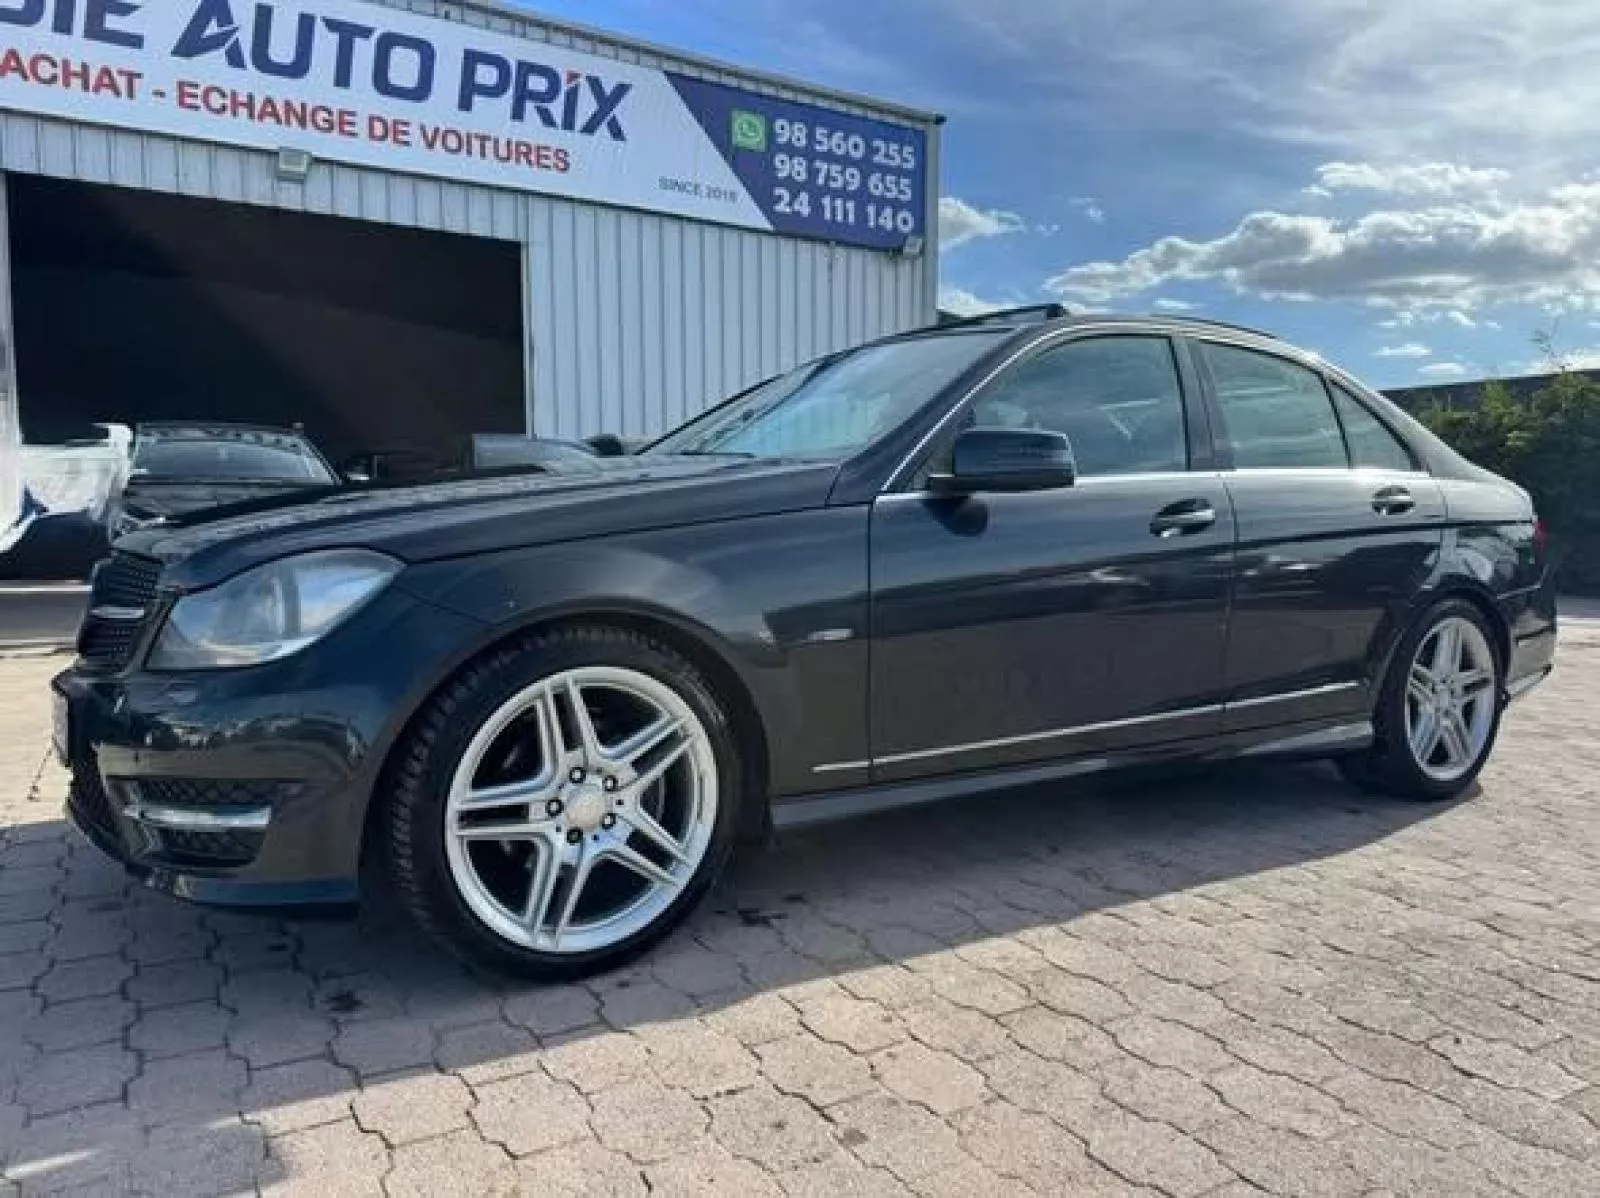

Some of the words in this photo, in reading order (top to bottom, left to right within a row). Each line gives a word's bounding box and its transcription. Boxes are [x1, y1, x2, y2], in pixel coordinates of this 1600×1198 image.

[171, 0, 436, 102] AUTO
[0, 48, 143, 100] ACHAT
[176, 80, 358, 138] ECHANGE
[368, 114, 412, 146] DE
[420, 124, 570, 172] VOITURES
[774, 119, 807, 147] 98
[815, 127, 865, 159] 560
[872, 140, 915, 168] 255
[774, 154, 807, 181] 98
[814, 160, 860, 191] 759
[868, 173, 912, 200] 655
[773, 187, 811, 217] 24
[822, 195, 855, 225] 111
[867, 203, 914, 233] 140
